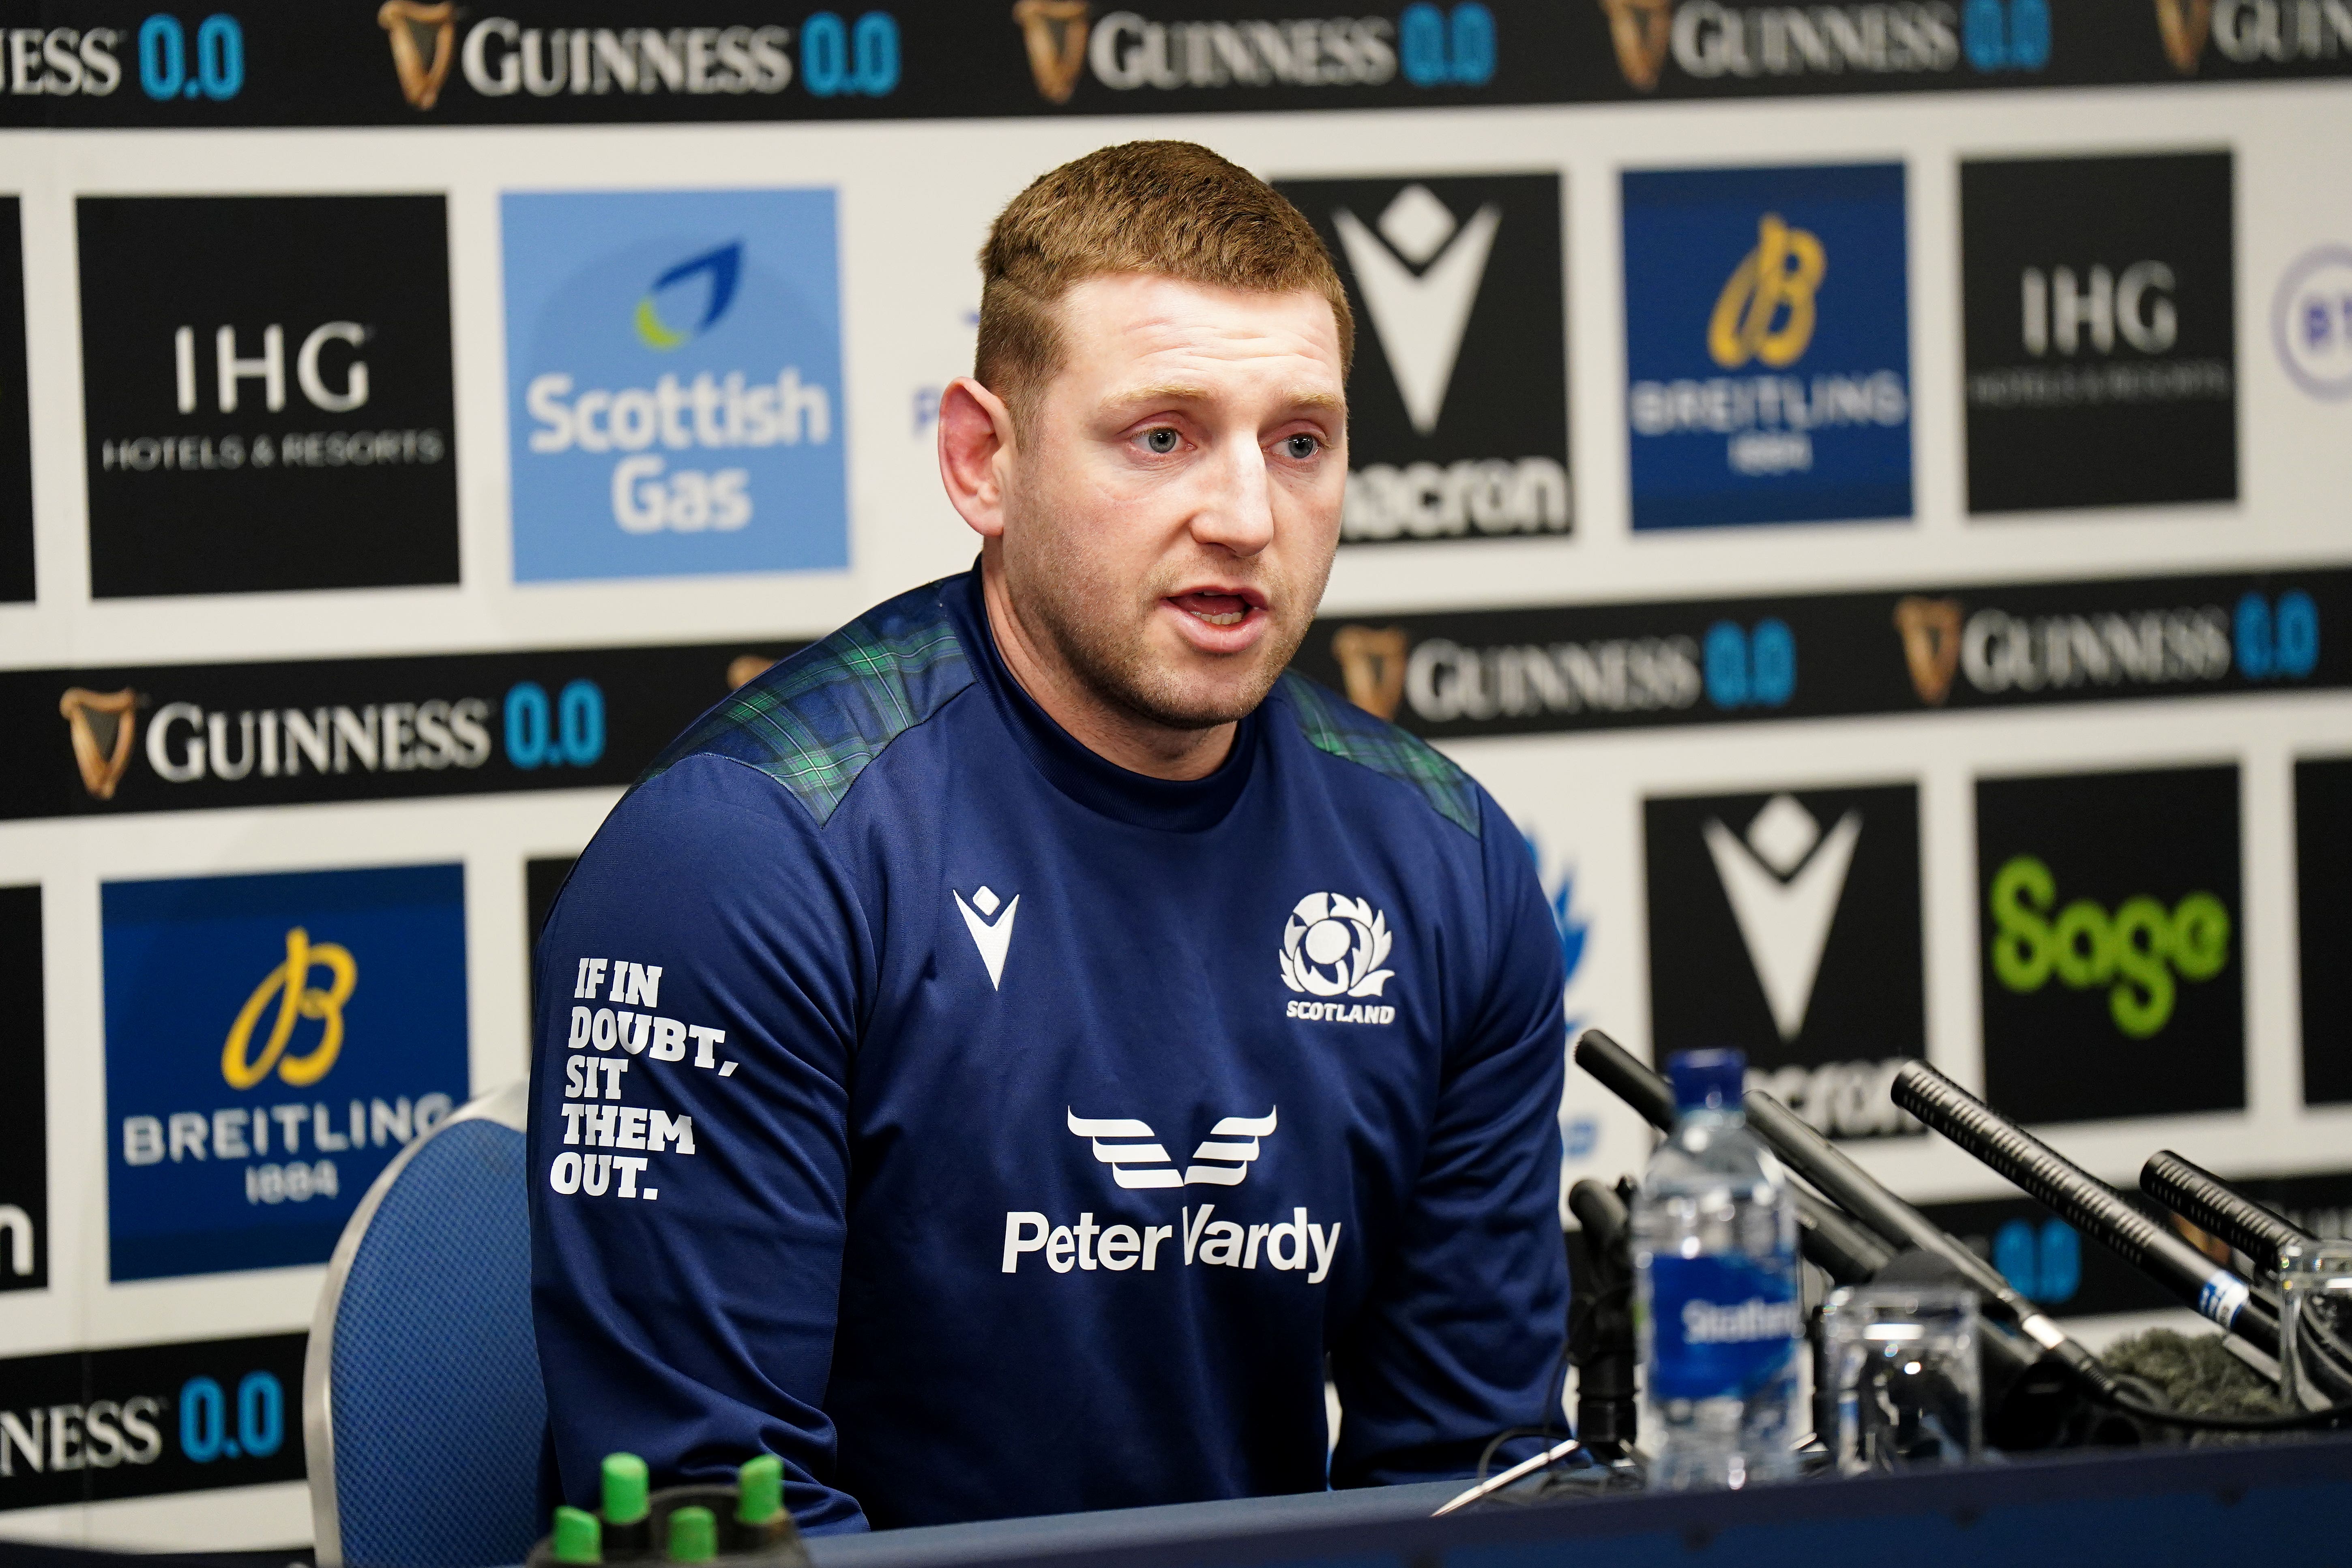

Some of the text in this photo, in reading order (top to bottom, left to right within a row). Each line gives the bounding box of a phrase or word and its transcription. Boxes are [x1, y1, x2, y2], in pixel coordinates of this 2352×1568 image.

[139, 14, 244, 100] 0.0
[462, 12, 899, 96] GUINNESS 0.0
[1089, 12, 1396, 88] GUINNESS
[2022, 263, 2177, 353] IHG
[176, 322, 368, 413] IHG
[527, 364, 830, 453] Scottish
[103, 435, 243, 470] HOTELS
[611, 452, 752, 534] Gas
[146, 680, 605, 783] GUINNESS 0.0
[574, 957, 663, 1008] IF IN
[1286, 1000, 1395, 1025] SCOTLAND
[565, 1055, 628, 1100] SIT
[568, 1006, 739, 1077] DOUBT,
[561, 1103, 696, 1155] THEM
[550, 1152, 659, 1200] OUT.
[1002, 1203, 1341, 1284] Peter Vardy
[179, 1371, 284, 1463] 0.0
